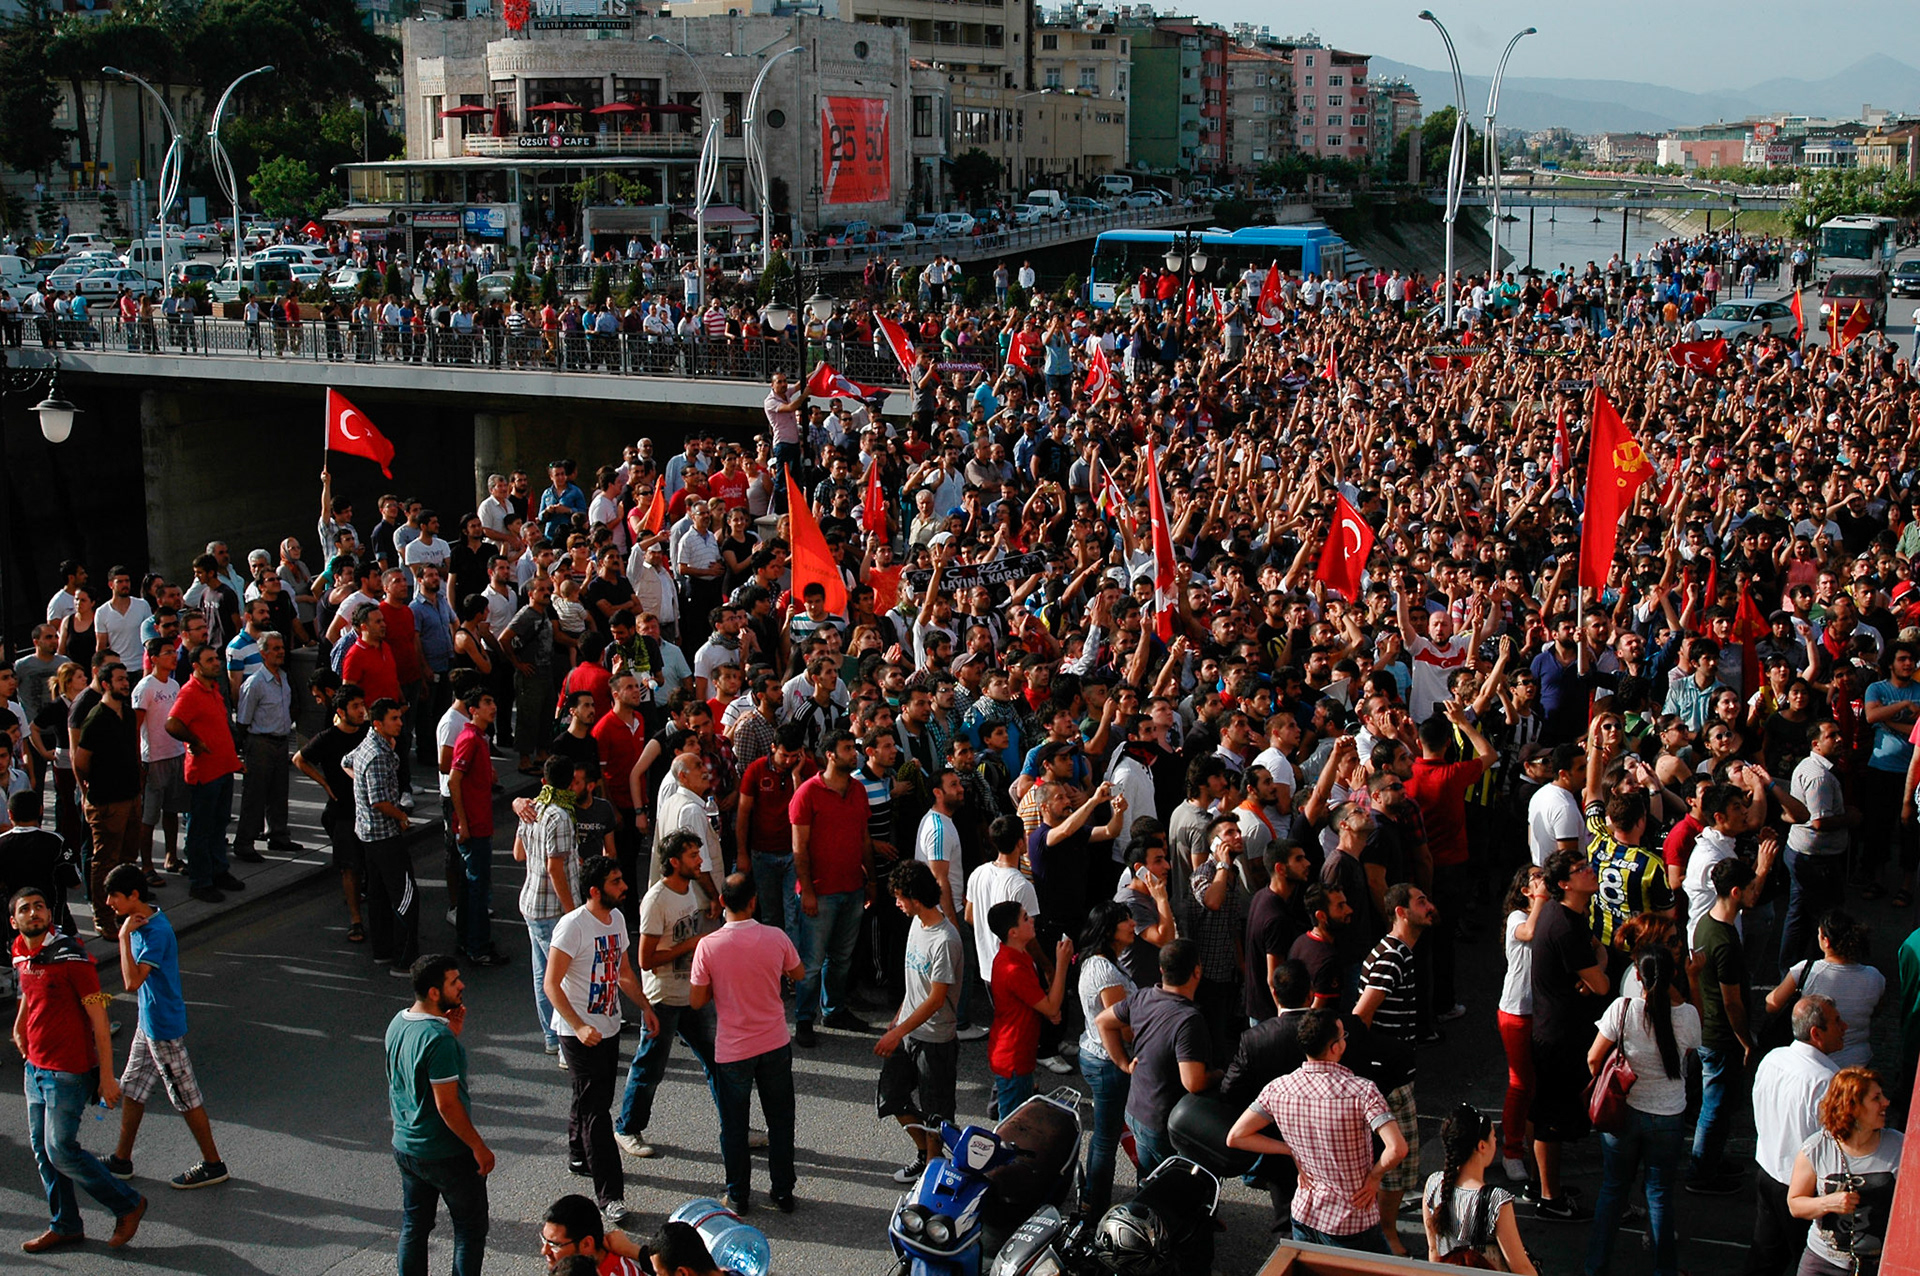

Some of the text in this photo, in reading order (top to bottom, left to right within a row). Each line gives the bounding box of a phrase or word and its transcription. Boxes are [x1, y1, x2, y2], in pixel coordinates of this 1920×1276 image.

[520, 137, 548, 147] ÖZSÜT
[563, 137, 590, 146] CAFE
[830, 125, 884, 162] 25 50
[1600, 867, 1625, 905] 8
